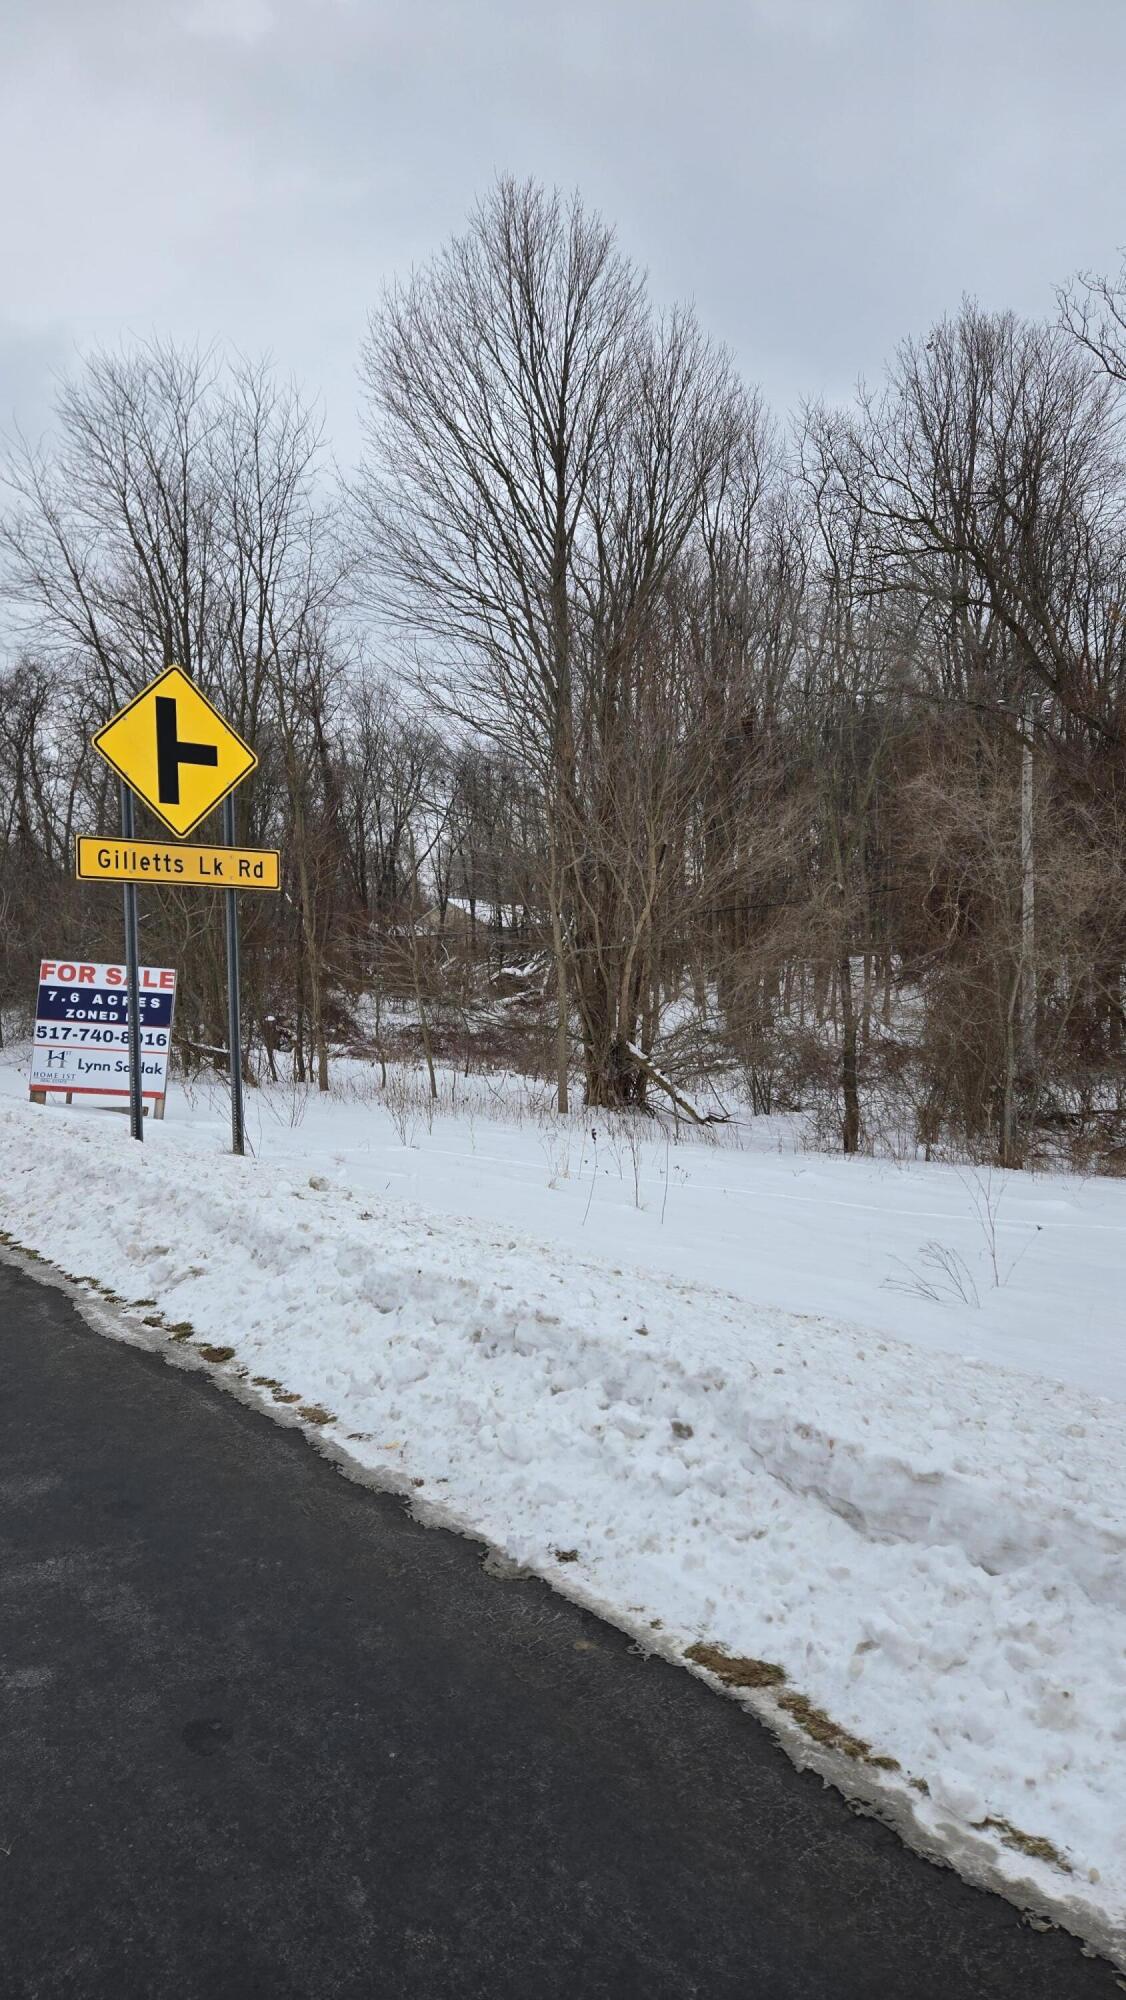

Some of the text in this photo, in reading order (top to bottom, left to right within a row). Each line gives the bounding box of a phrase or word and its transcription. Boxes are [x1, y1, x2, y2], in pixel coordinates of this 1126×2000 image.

[98, 849, 264, 879] Gilletts Lk Rd
[41, 963, 175, 989] FOR SLE
[48, 991, 80, 1003] 7.6
[65, 1009, 119, 1021] ZONED
[36, 1026, 167, 1046] 517-740-816
[77, 1058, 163, 1075] Lynn Sadak
[33, 1071, 60, 1080] HOME
